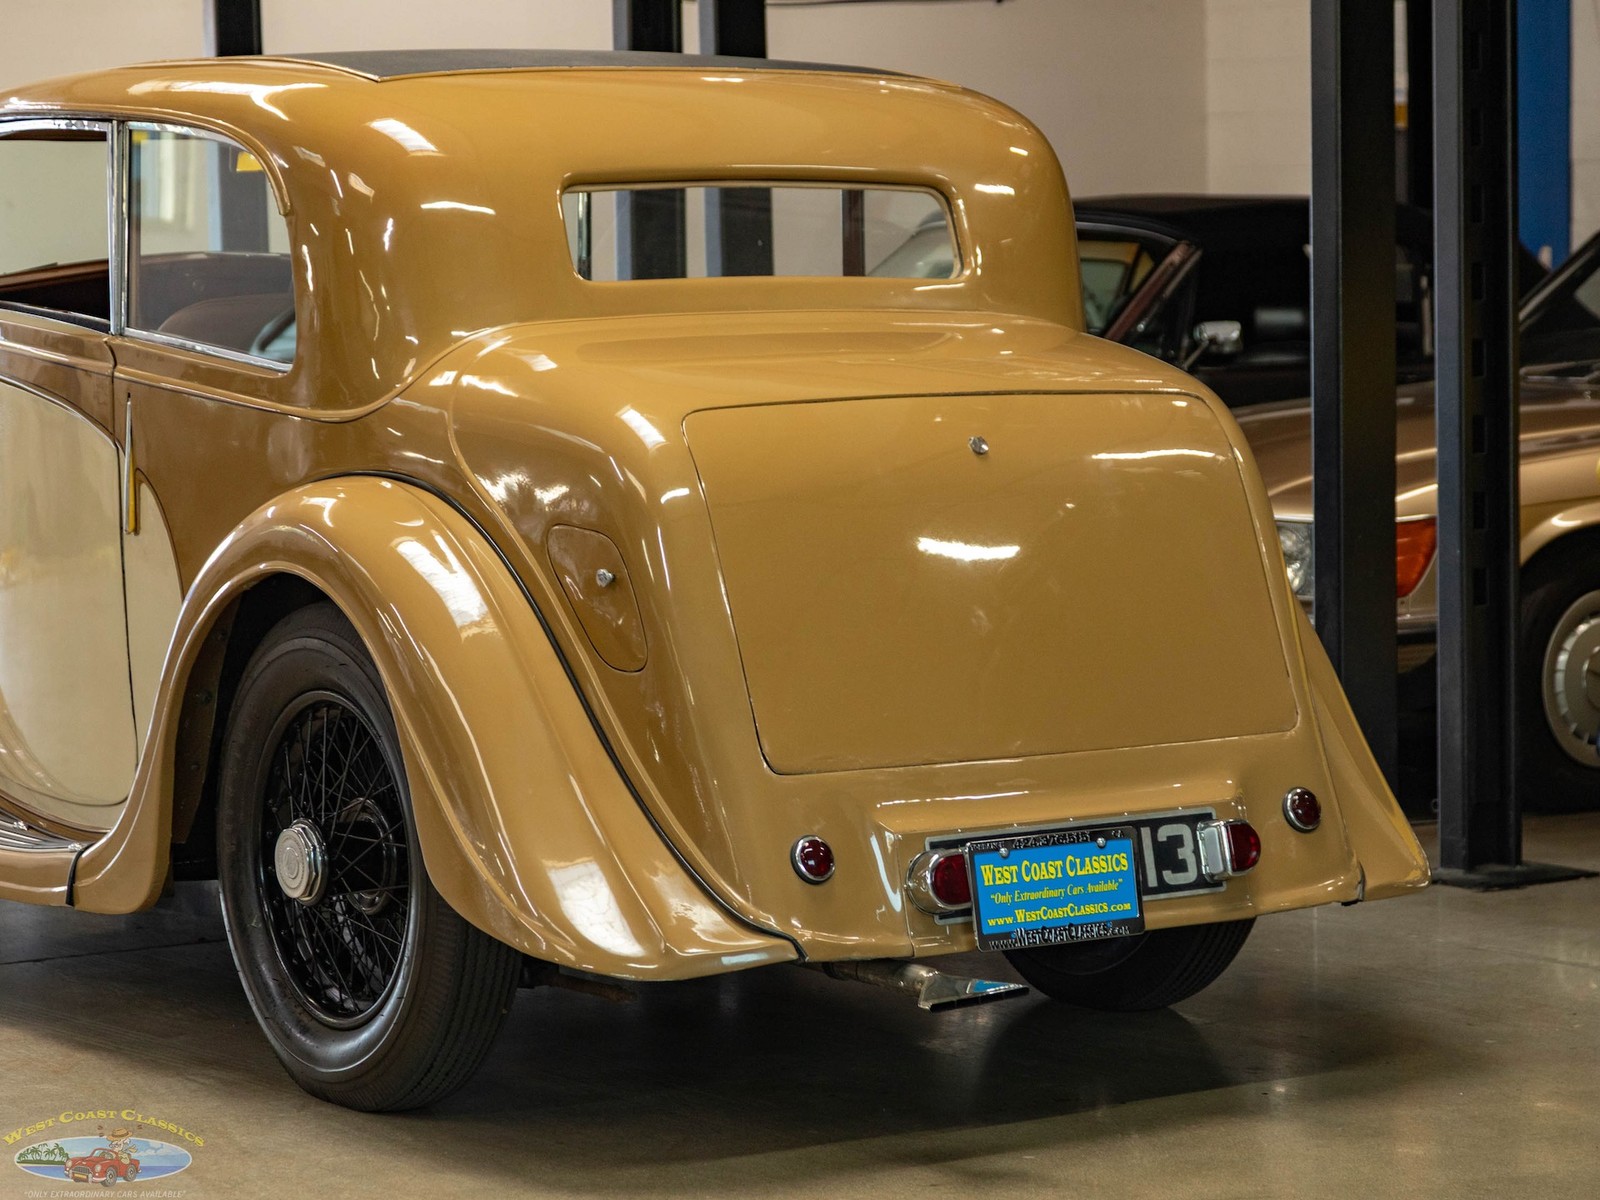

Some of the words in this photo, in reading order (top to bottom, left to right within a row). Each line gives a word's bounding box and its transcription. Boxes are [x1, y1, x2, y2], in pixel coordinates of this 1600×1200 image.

[980, 864, 1018, 886] WEST
[1021, 860, 1063, 882] COAST
[1066, 852, 1129, 877] CLASSICS
[1014, 886, 1066, 902] Extraordinary
[1067, 883, 1084, 896] Cars
